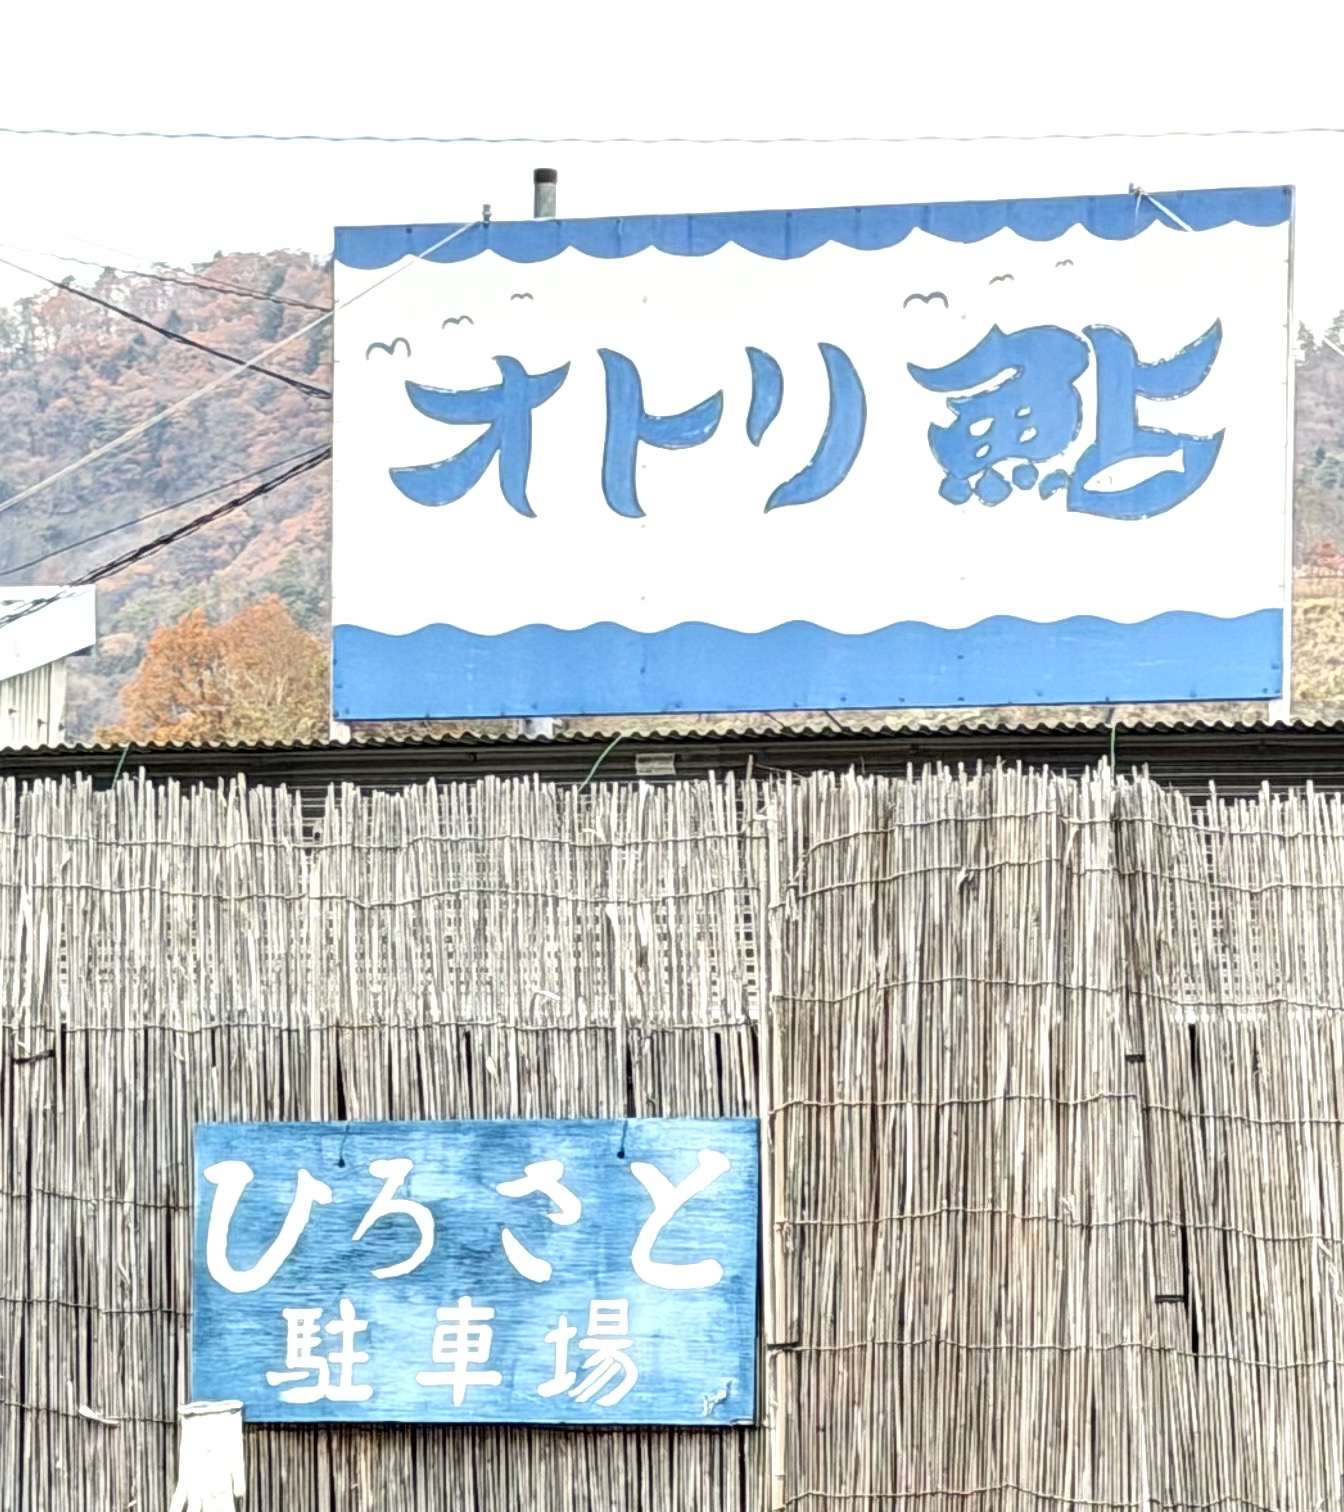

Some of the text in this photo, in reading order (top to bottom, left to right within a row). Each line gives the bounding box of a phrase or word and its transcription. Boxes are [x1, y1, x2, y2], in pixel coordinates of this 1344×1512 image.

[203, 1150, 731, 1293] ひろさと
[265, 1296, 639, 1406] 駐車場
